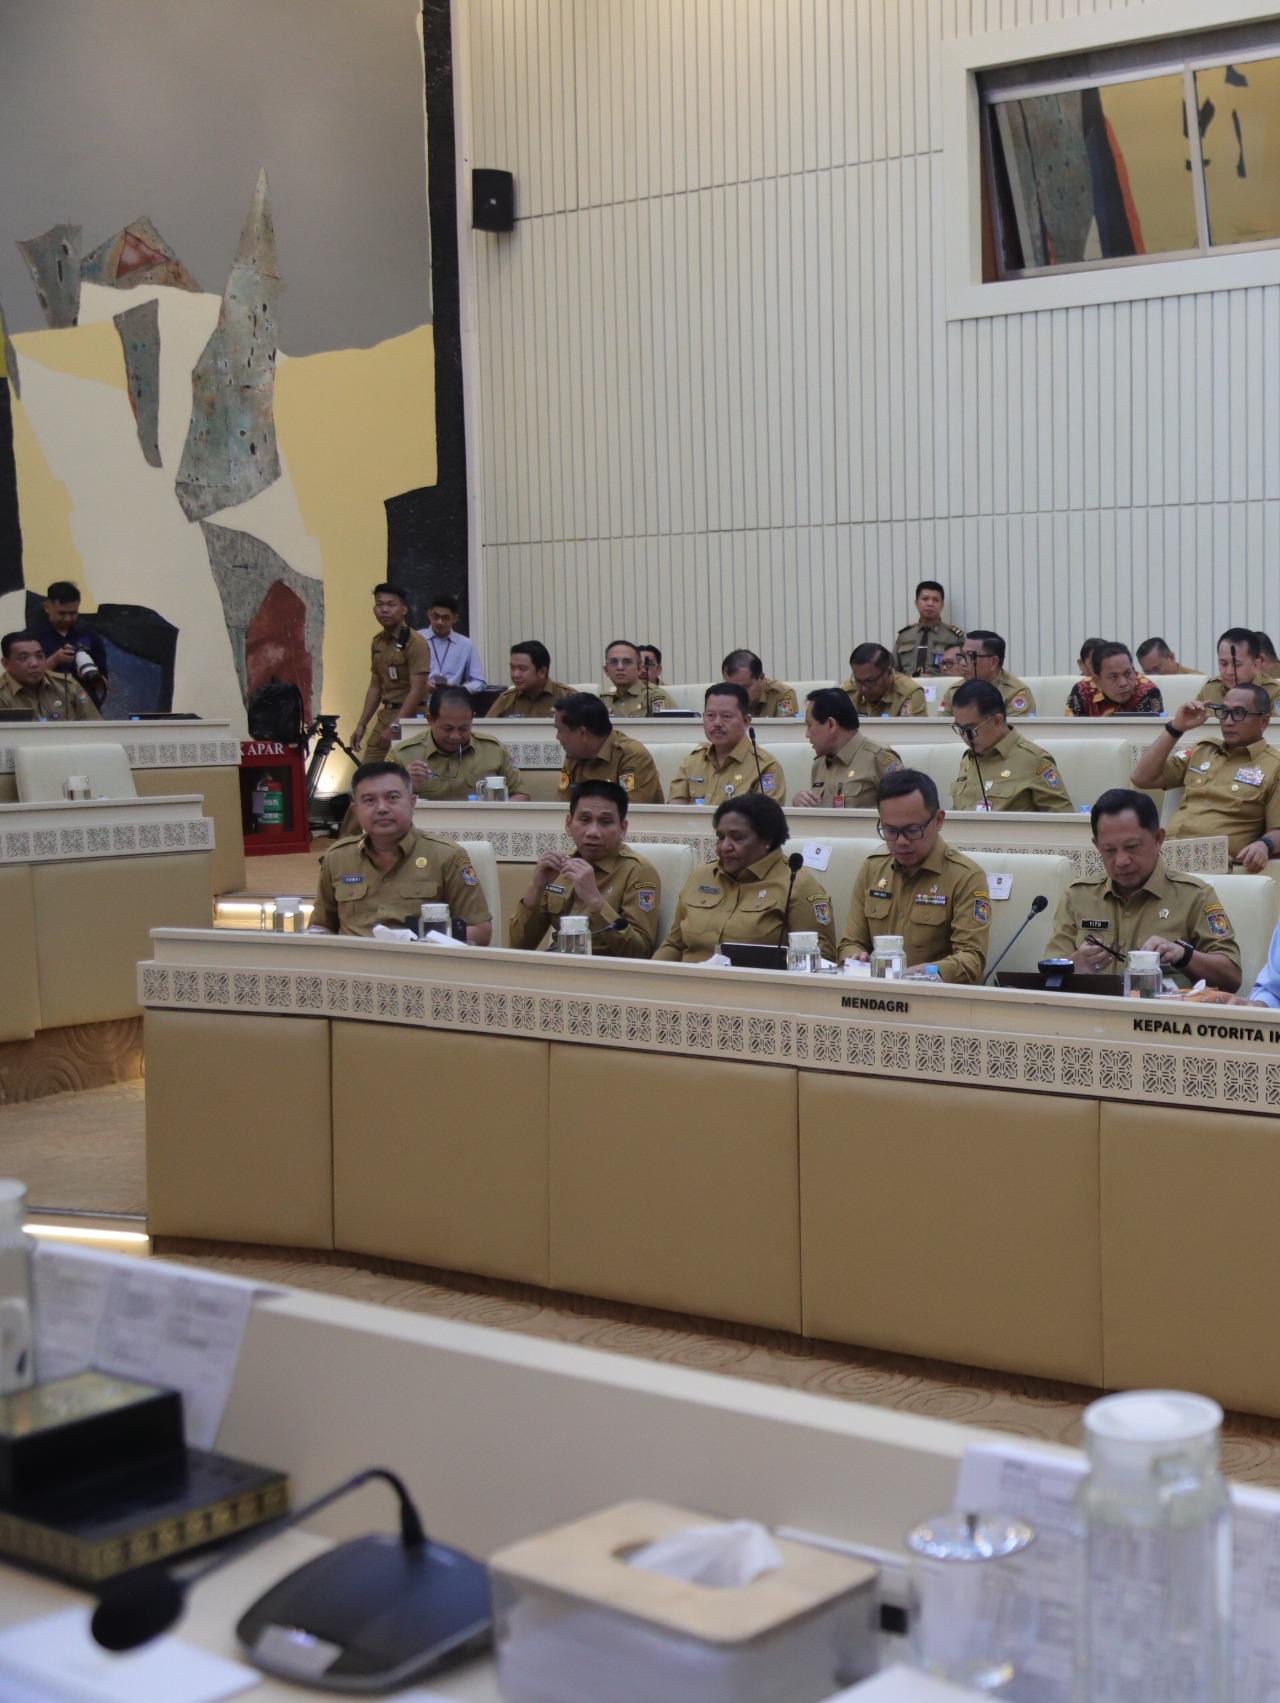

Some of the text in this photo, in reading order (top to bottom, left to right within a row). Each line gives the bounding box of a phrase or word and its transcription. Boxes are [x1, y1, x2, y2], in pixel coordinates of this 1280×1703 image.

[247, 743, 286, 756] APAR
[841, 996, 909, 1013] MENDAGRI
[1133, 1019, 1192, 1035] KEPALA
[1196, 1024, 1264, 1042] OTORITA
